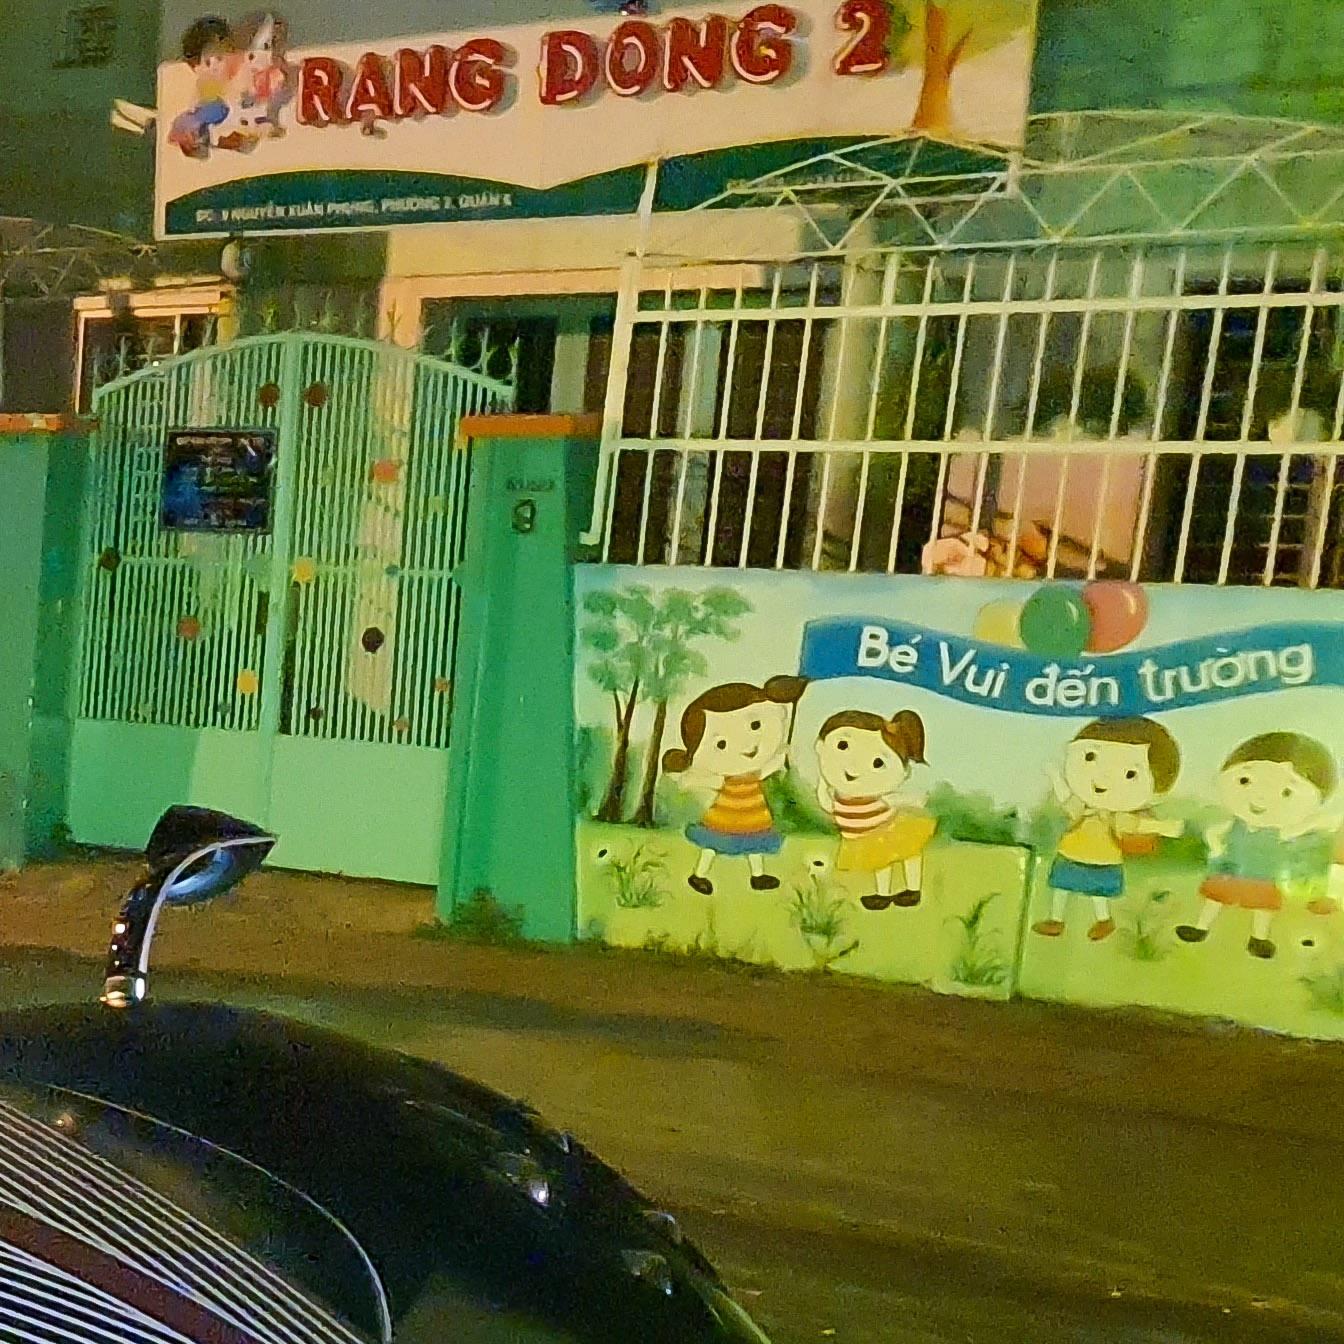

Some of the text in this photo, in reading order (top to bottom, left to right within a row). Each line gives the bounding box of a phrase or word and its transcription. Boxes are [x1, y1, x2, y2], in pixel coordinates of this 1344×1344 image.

[832, 0, 891, 75] 2
[857, 625, 923, 673] Bé
[938, 641, 1011, 699] Vui
[1025, 662, 1120, 708] đến
